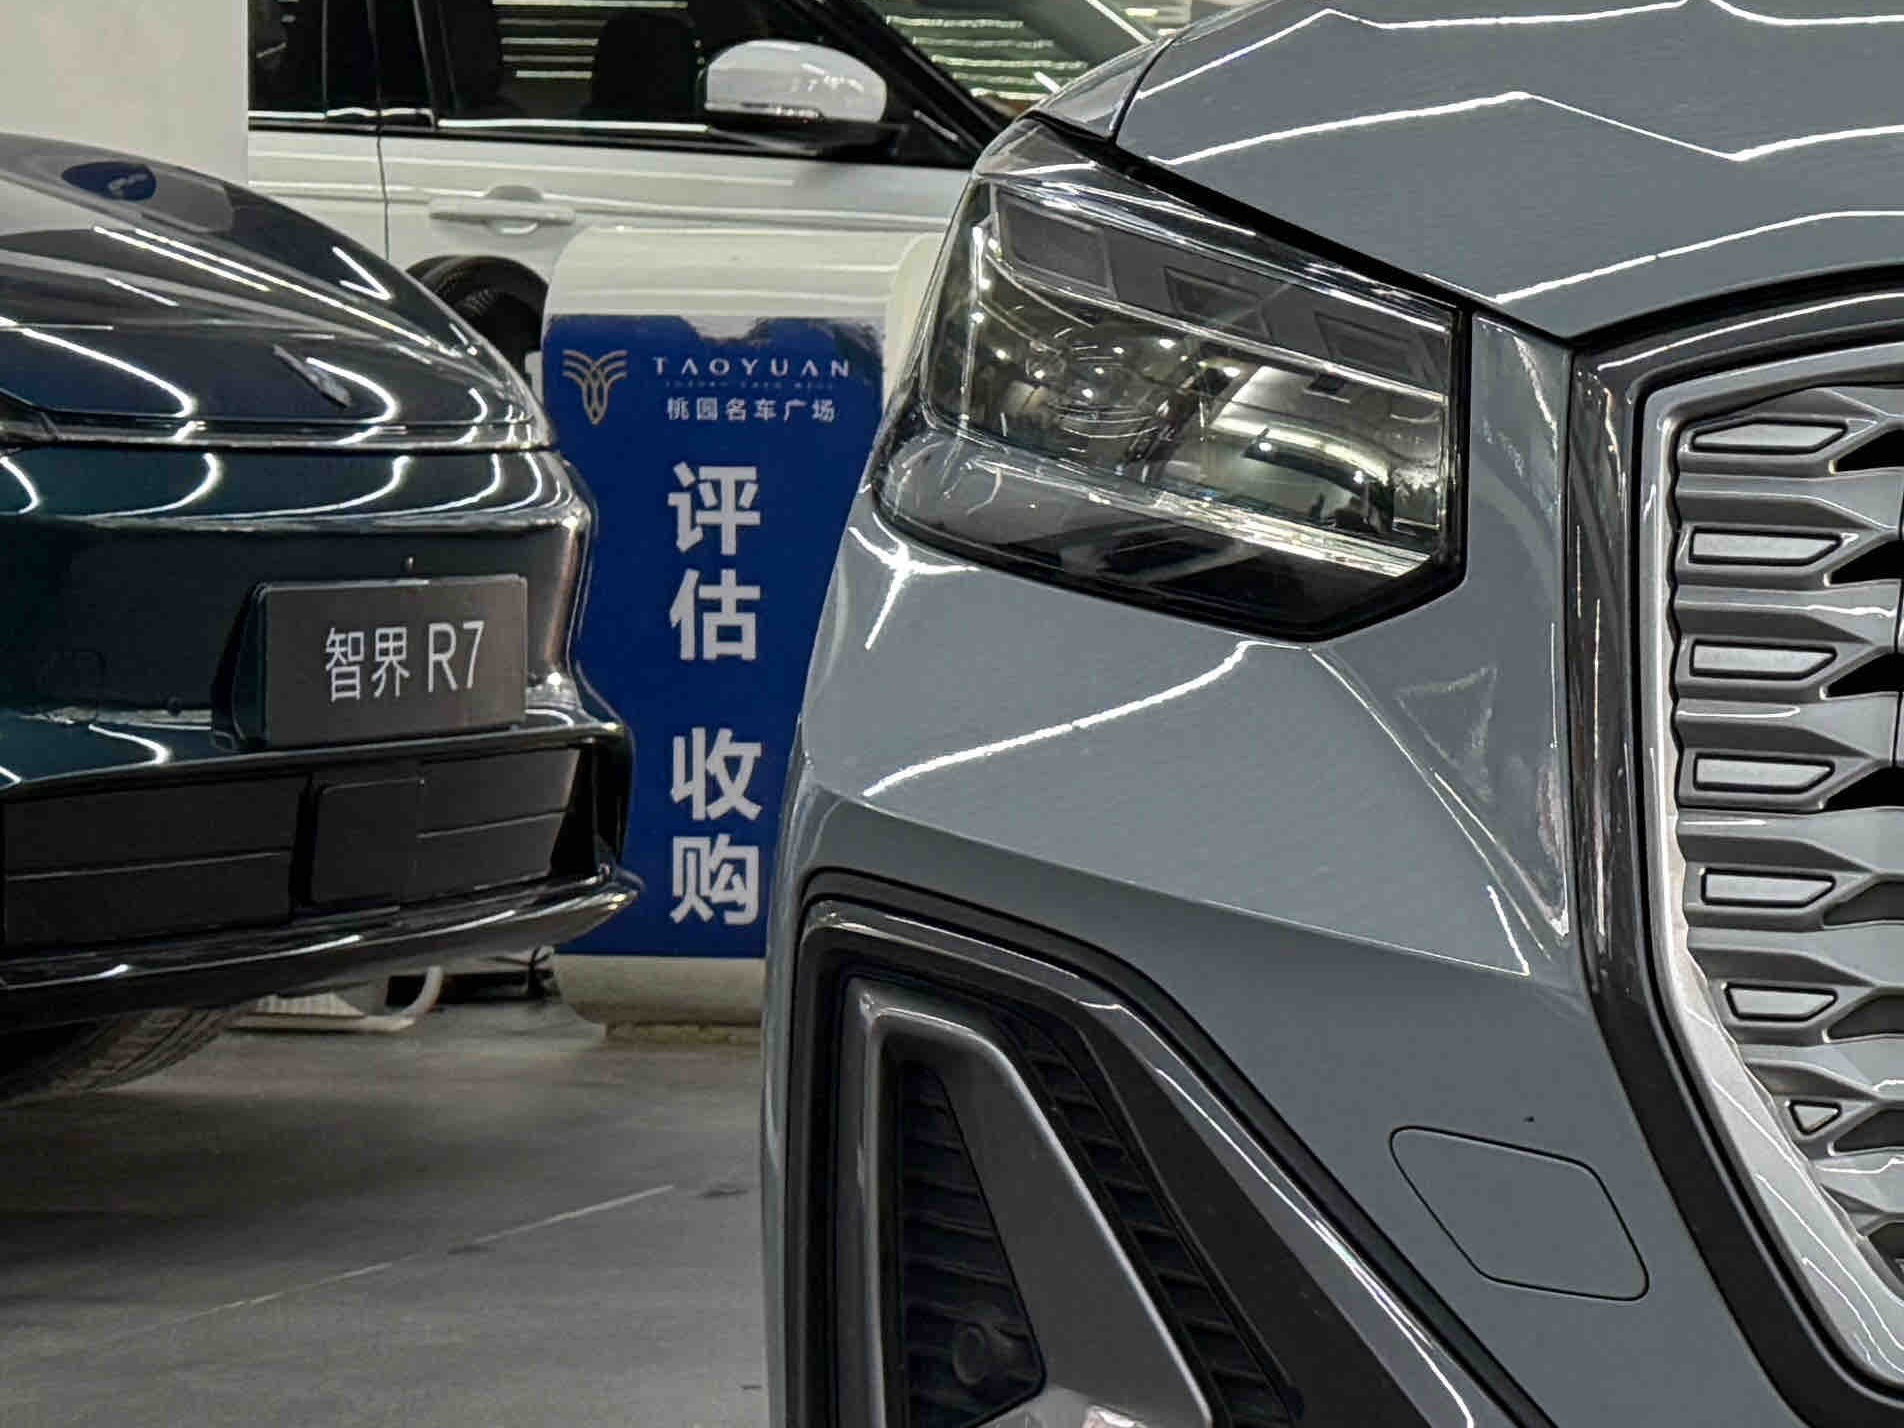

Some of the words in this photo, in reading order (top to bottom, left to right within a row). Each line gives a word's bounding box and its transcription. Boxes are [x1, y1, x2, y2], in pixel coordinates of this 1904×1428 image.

[652, 356, 849, 377] TAOYUAN
[667, 397, 835, 422] 桃园名车广场
[667, 462, 761, 662] 评估
[325, 625, 411, 702] 智界
[426, 619, 486, 693] R7
[669, 726, 763, 925] 收购
